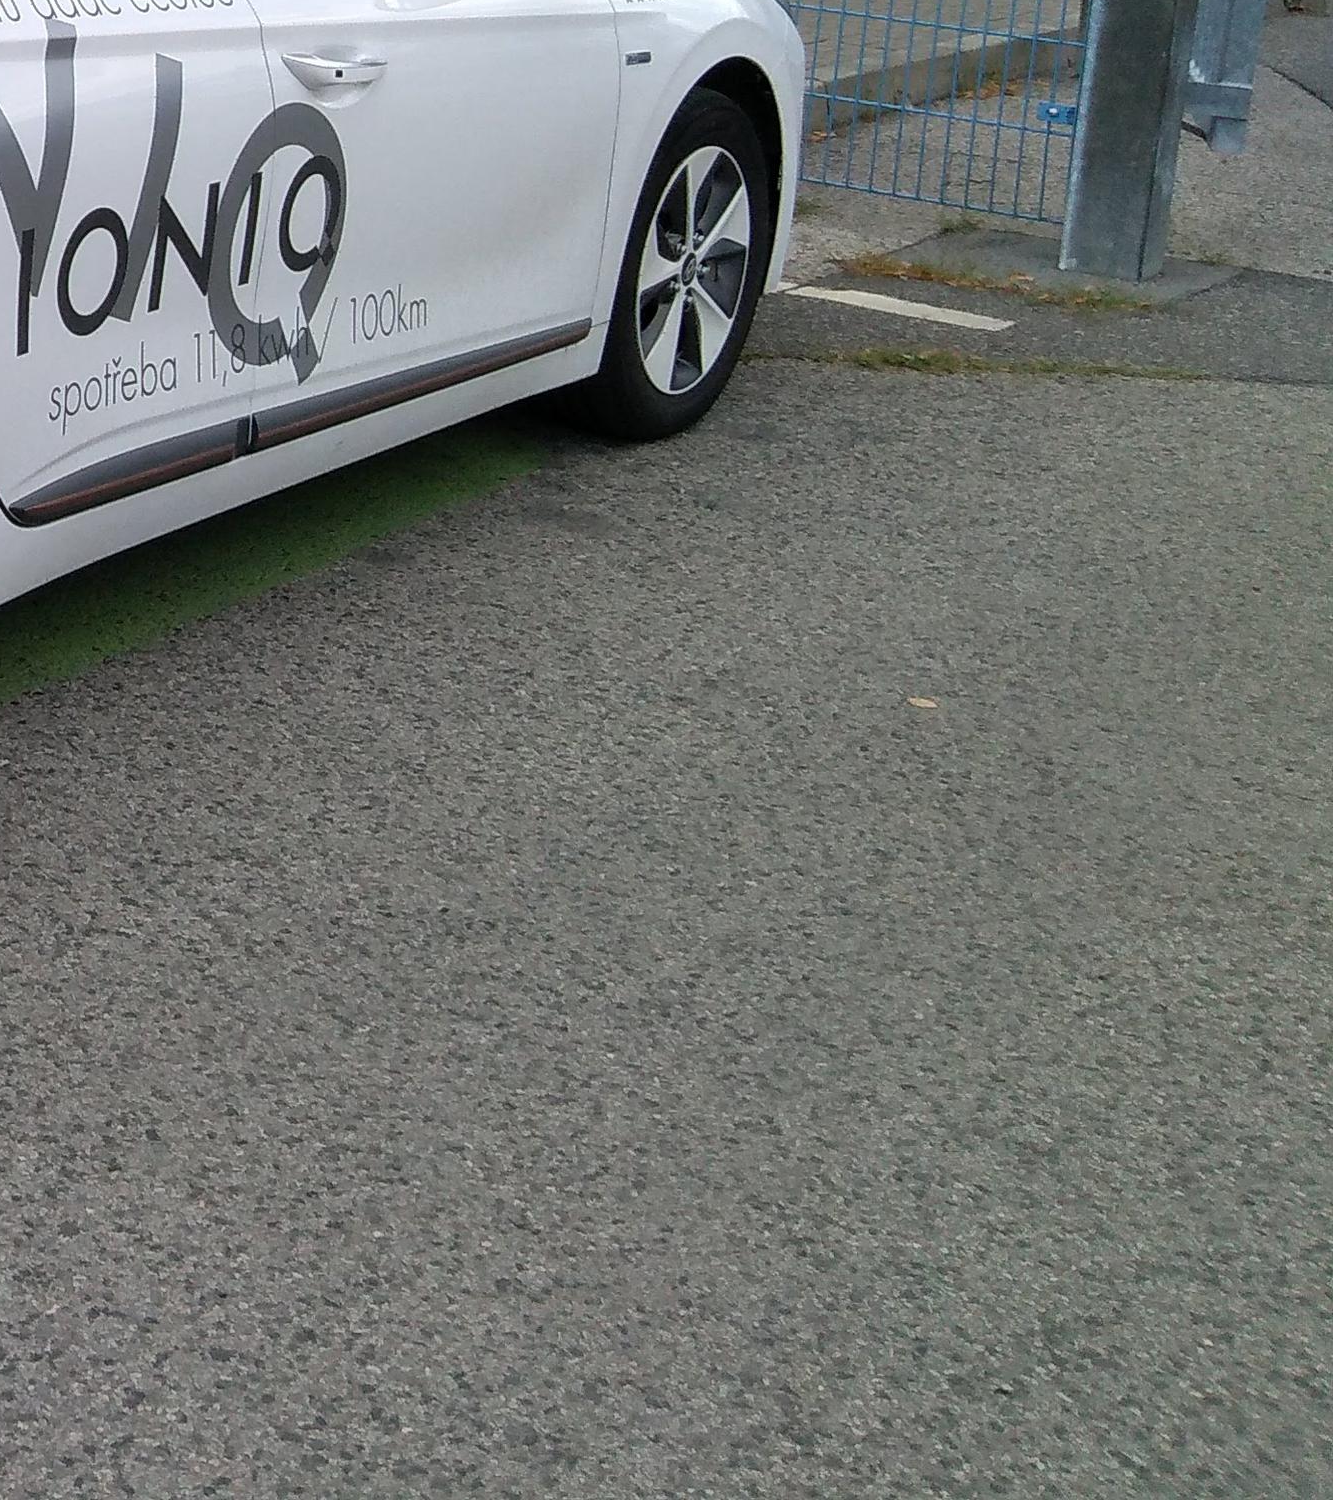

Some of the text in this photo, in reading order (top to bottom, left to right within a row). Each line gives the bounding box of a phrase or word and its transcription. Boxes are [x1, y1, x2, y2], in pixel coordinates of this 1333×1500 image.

[16, 154, 342, 357] IONIQ
[47, 340, 179, 436] spotřeba
[193, 322, 247, 387] 11,8
[350, 283, 430, 345] 100km
